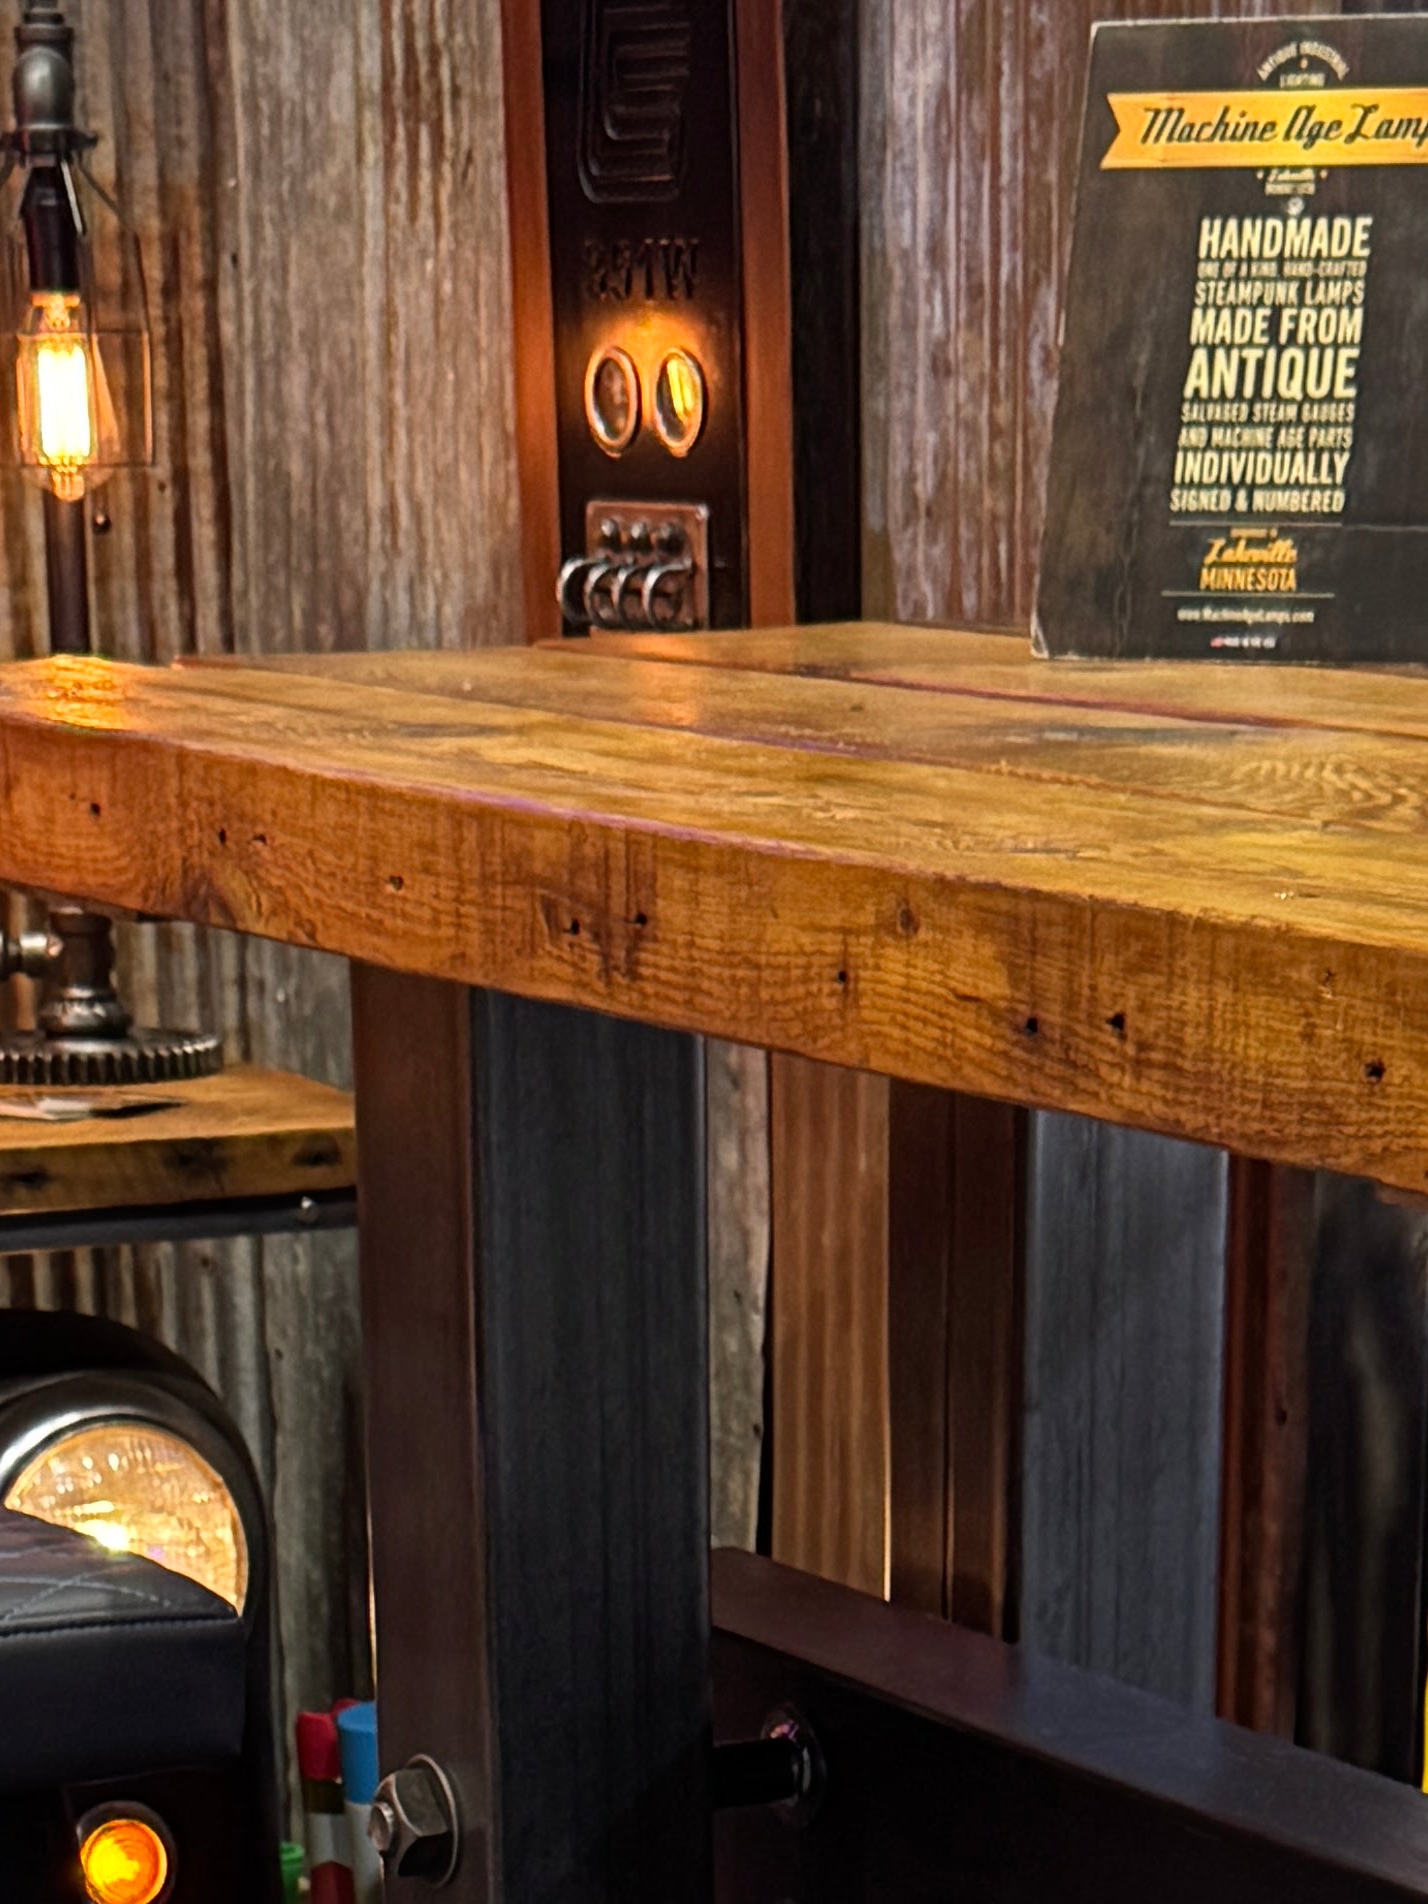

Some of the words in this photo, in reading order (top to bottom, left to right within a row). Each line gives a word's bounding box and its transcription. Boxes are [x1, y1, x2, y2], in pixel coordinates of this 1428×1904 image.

[1140, 105, 1279, 146] Machine
[1282, 105, 1343, 151] Age
[1198, 216, 1373, 259] HANDMADE
[1194, 281, 1300, 306] STEAMPUNK
[1304, 280, 1365, 306] LAMPS
[1190, 307, 1272, 346] MADE
[1279, 307, 1364, 346] FROM
[1183, 347, 1361, 401] ANTIQUE
[1181, 402, 1249, 423] SALVAGED
[1252, 402, 1299, 423] STEAM
[1300, 402, 1356, 423] GAUGES
[1177, 426, 1208, 449] AND
[1210, 426, 1274, 449] MACHINE
[1276, 426, 1305, 449] AGE
[1308, 426, 1354, 449] PARTS
[1174, 450, 1351, 486] INDIVIDUALLY
[1169, 487, 1232, 512] SIGNED
[1234, 487, 1248, 512] &
[1252, 488, 1346, 513] NUMBERED
[1203, 538, 1298, 565] Lakeville
[1199, 567, 1297, 592] MINNESOTA
